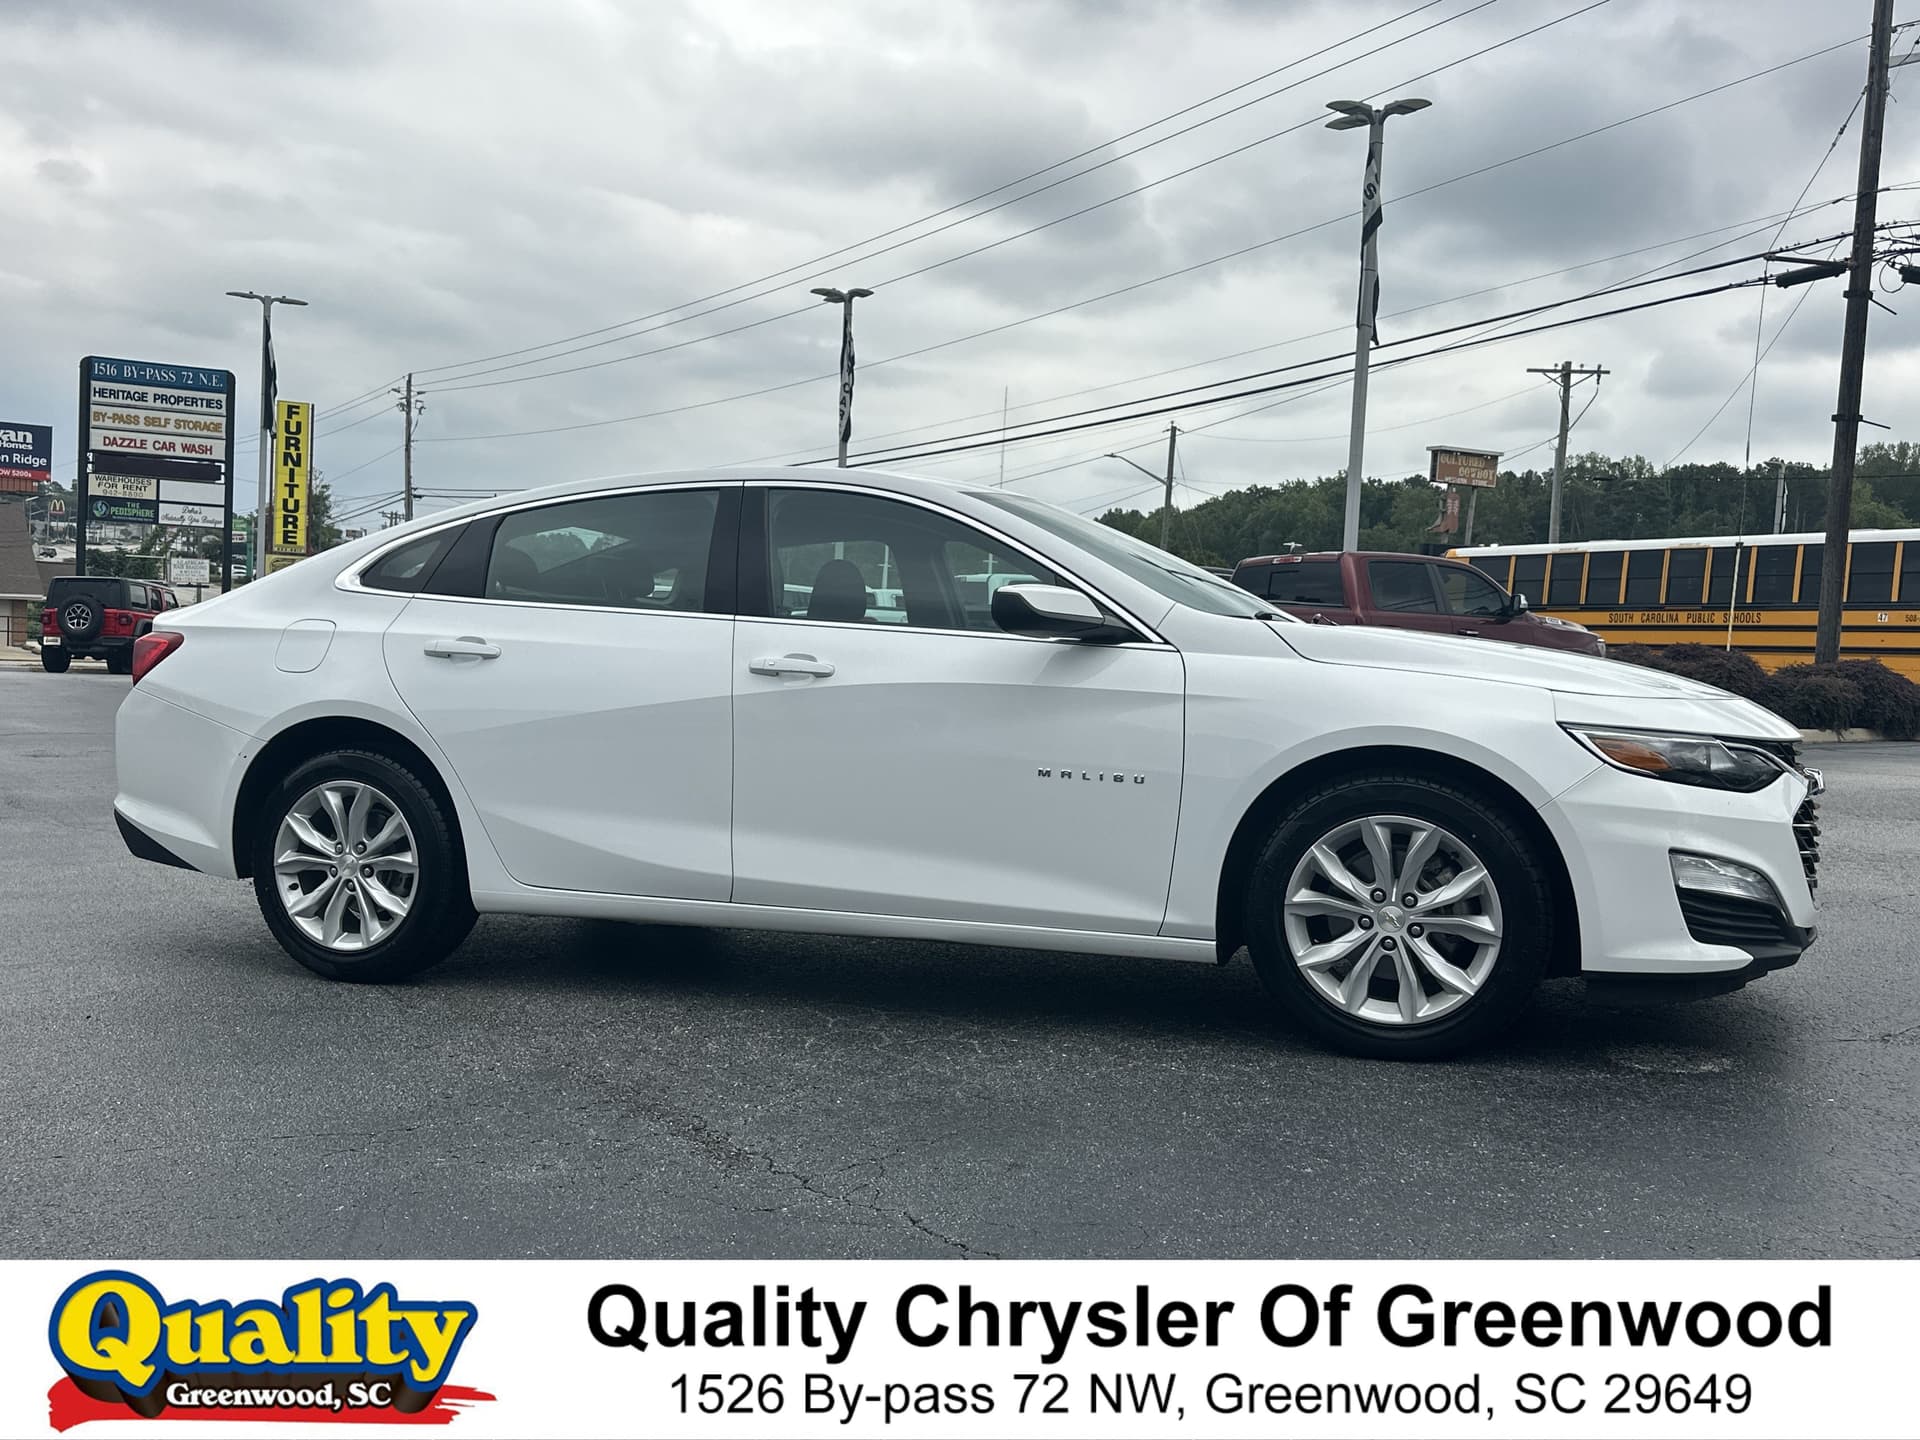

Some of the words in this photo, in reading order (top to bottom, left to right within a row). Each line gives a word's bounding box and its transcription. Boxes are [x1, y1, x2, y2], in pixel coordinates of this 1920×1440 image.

[94, 362, 117, 376] 1516
[123, 365, 176, 383] BY-PASS
[182, 371, 193, 384] 72
[199, 373, 223, 387] N.E.
[93, 387, 148, 402] HERITAGE
[153, 393, 223, 409] PROPERTIES
[92, 411, 140, 425] BY-PASS
[143, 416, 171, 428] SELF
[174, 419, 223, 433] STORAGE
[103, 436, 148, 450] DAZZLE
[152, 440, 176, 452] CAR
[181, 443, 213, 455] WASH
[13, 453, 47, 467] Ridge
[95, 474, 152, 486] WAREHOUSES
[282, 404, 302, 545] FURNITURE
[97, 482, 118, 490] FOR
[122, 484, 148, 492] RENT
[110, 506, 155, 518] PEDISPHERE
[1608, 613, 1634, 623] SOUTH
[1641, 613, 1679, 623] CAROLINA
[1686, 613, 1715, 623] PUBLIC
[1037, 768, 1145, 784] MALIBU
